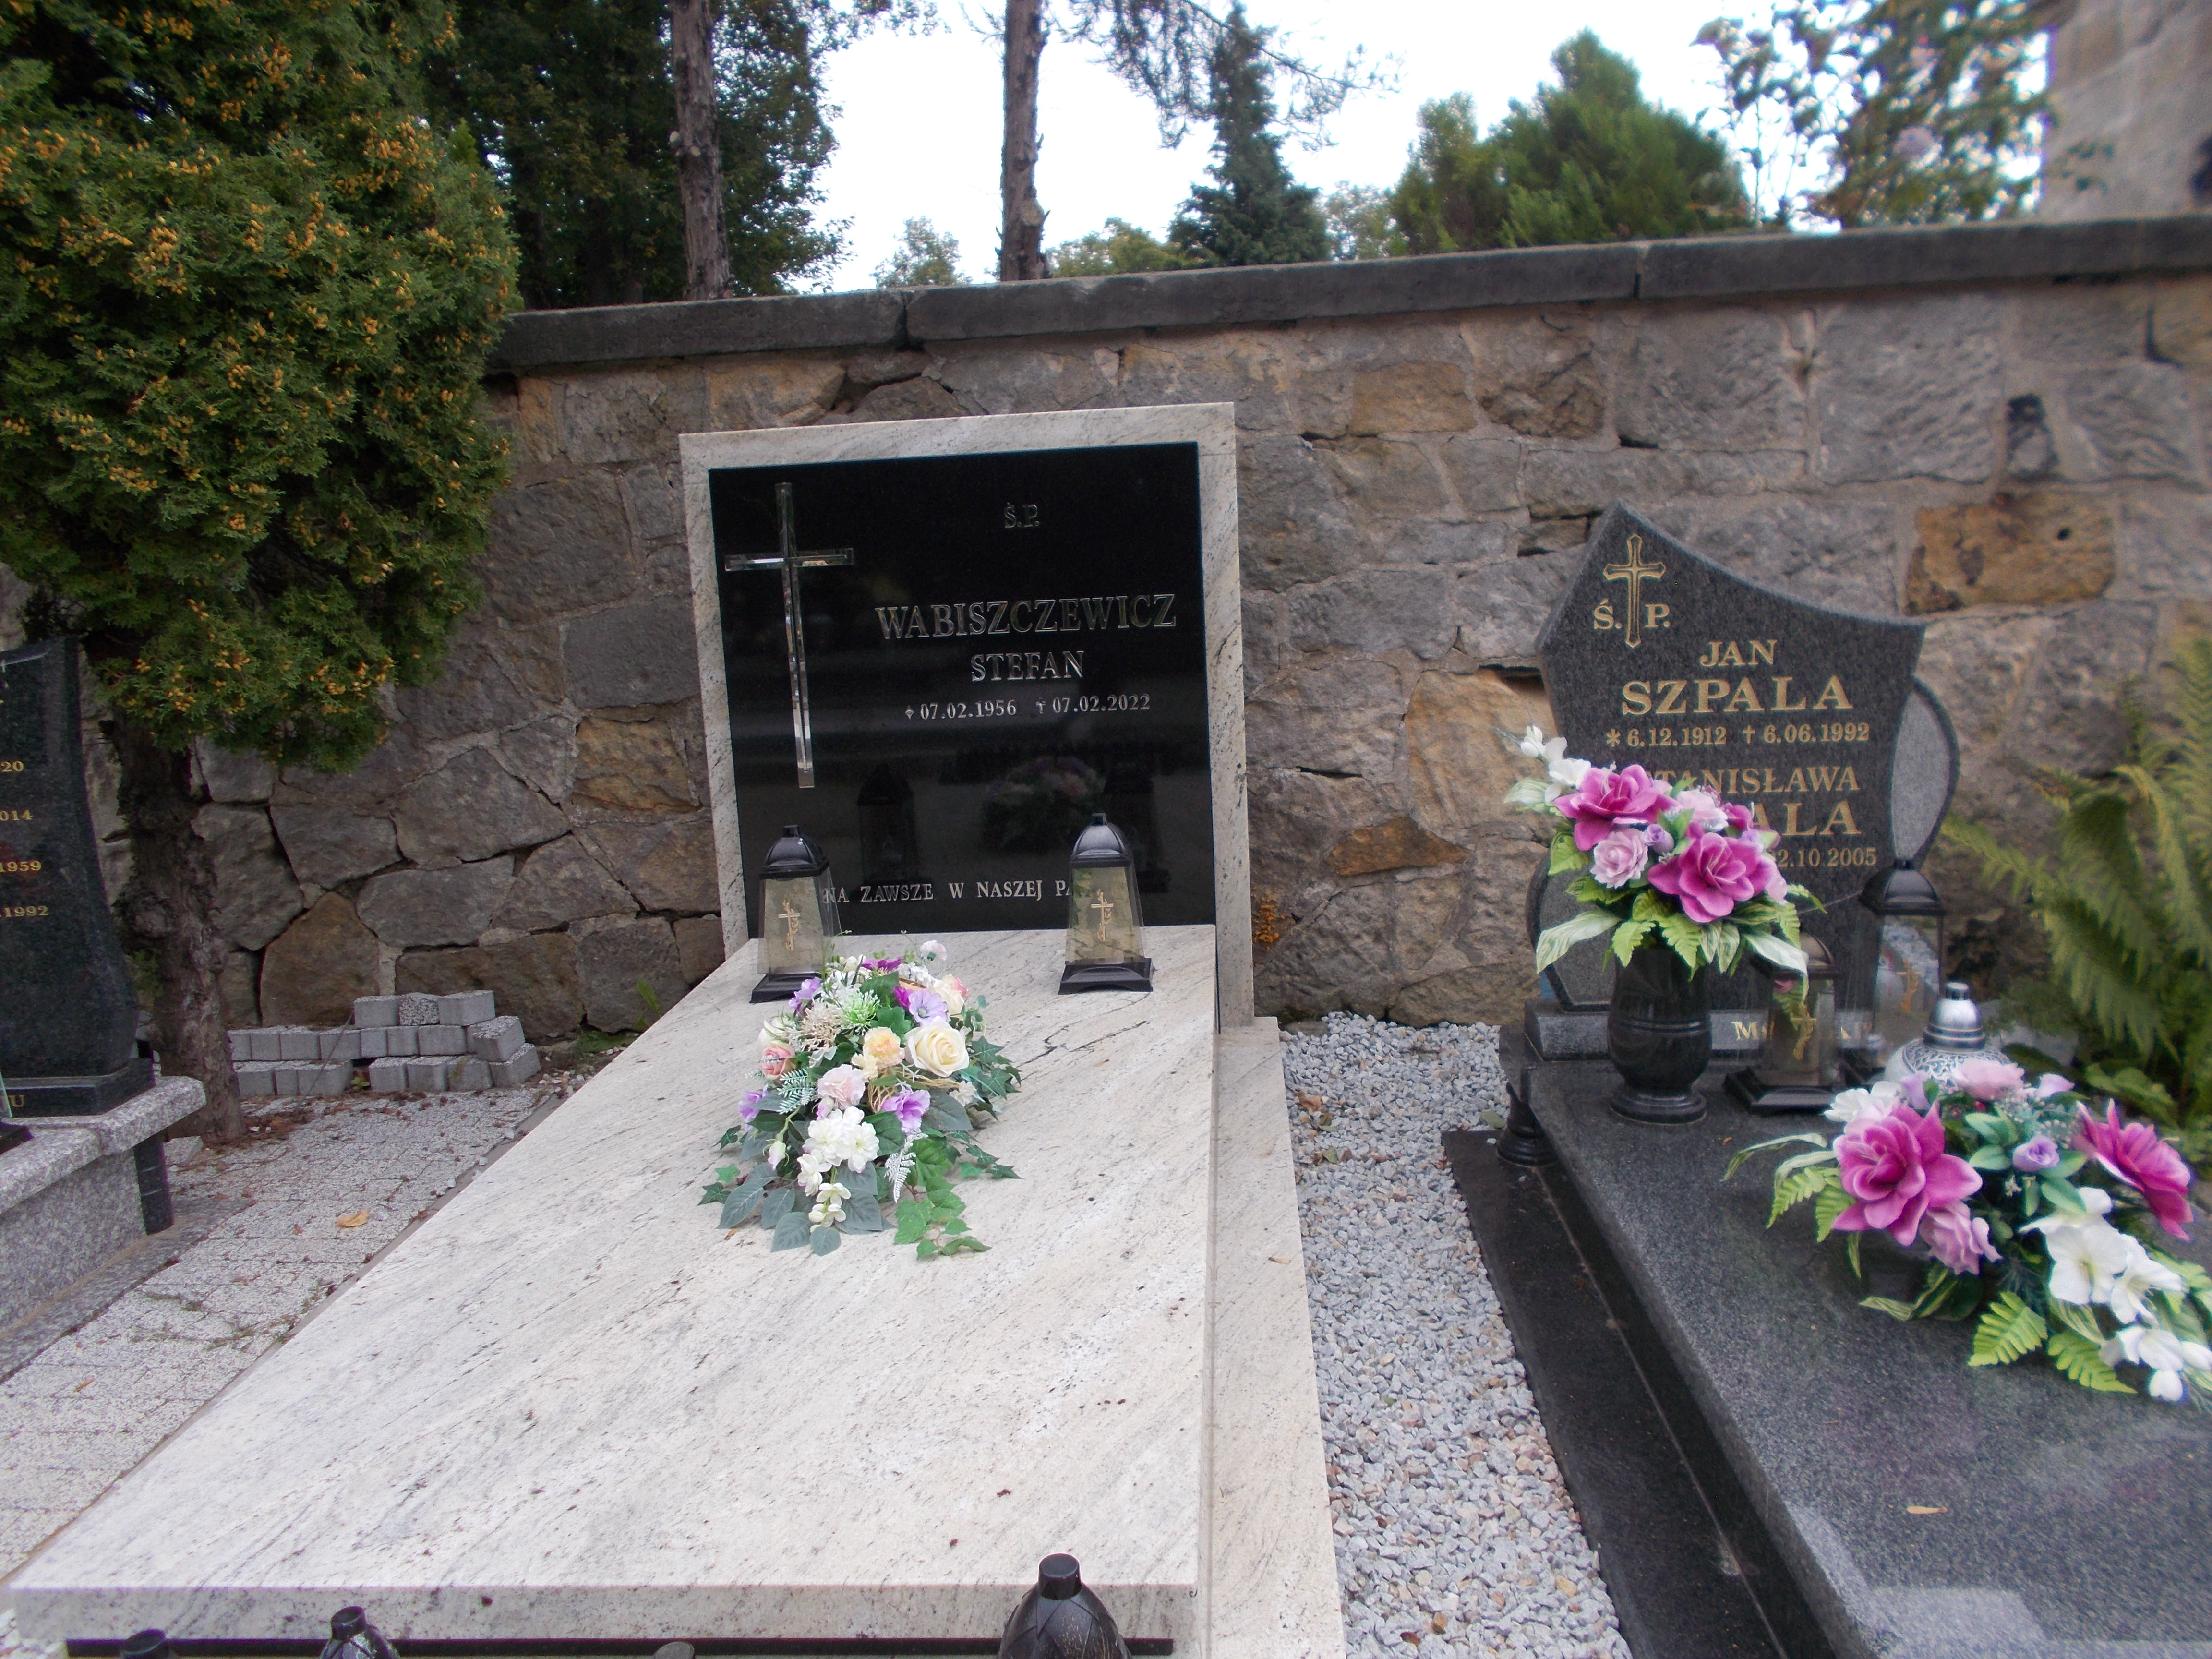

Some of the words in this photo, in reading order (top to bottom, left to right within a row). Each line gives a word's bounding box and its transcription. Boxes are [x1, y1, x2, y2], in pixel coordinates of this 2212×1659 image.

[875, 594, 1176, 639] WABISZCZEWICZ
[1644, 603, 1670, 628] P.
[970, 650, 1084, 682] STEFAN
[1699, 639, 1777, 667] JAN
[920, 699, 1017, 720] 07.02.1956
[1052, 693, 1150, 714] 07.02.2022
[1622, 674, 1853, 715] SZPALA
[1627, 726, 1727, 747] 6.12.1912
[1763, 722, 1870, 744] 6.06.1992
[1647, 766, 1861, 793] TANISŁAWA
[1751, 800, 1862, 836] ALA
[860, 883, 934, 902] ZAWSZE
[948, 882, 964, 899] W
[976, 880, 1043, 901] NASZEJ
